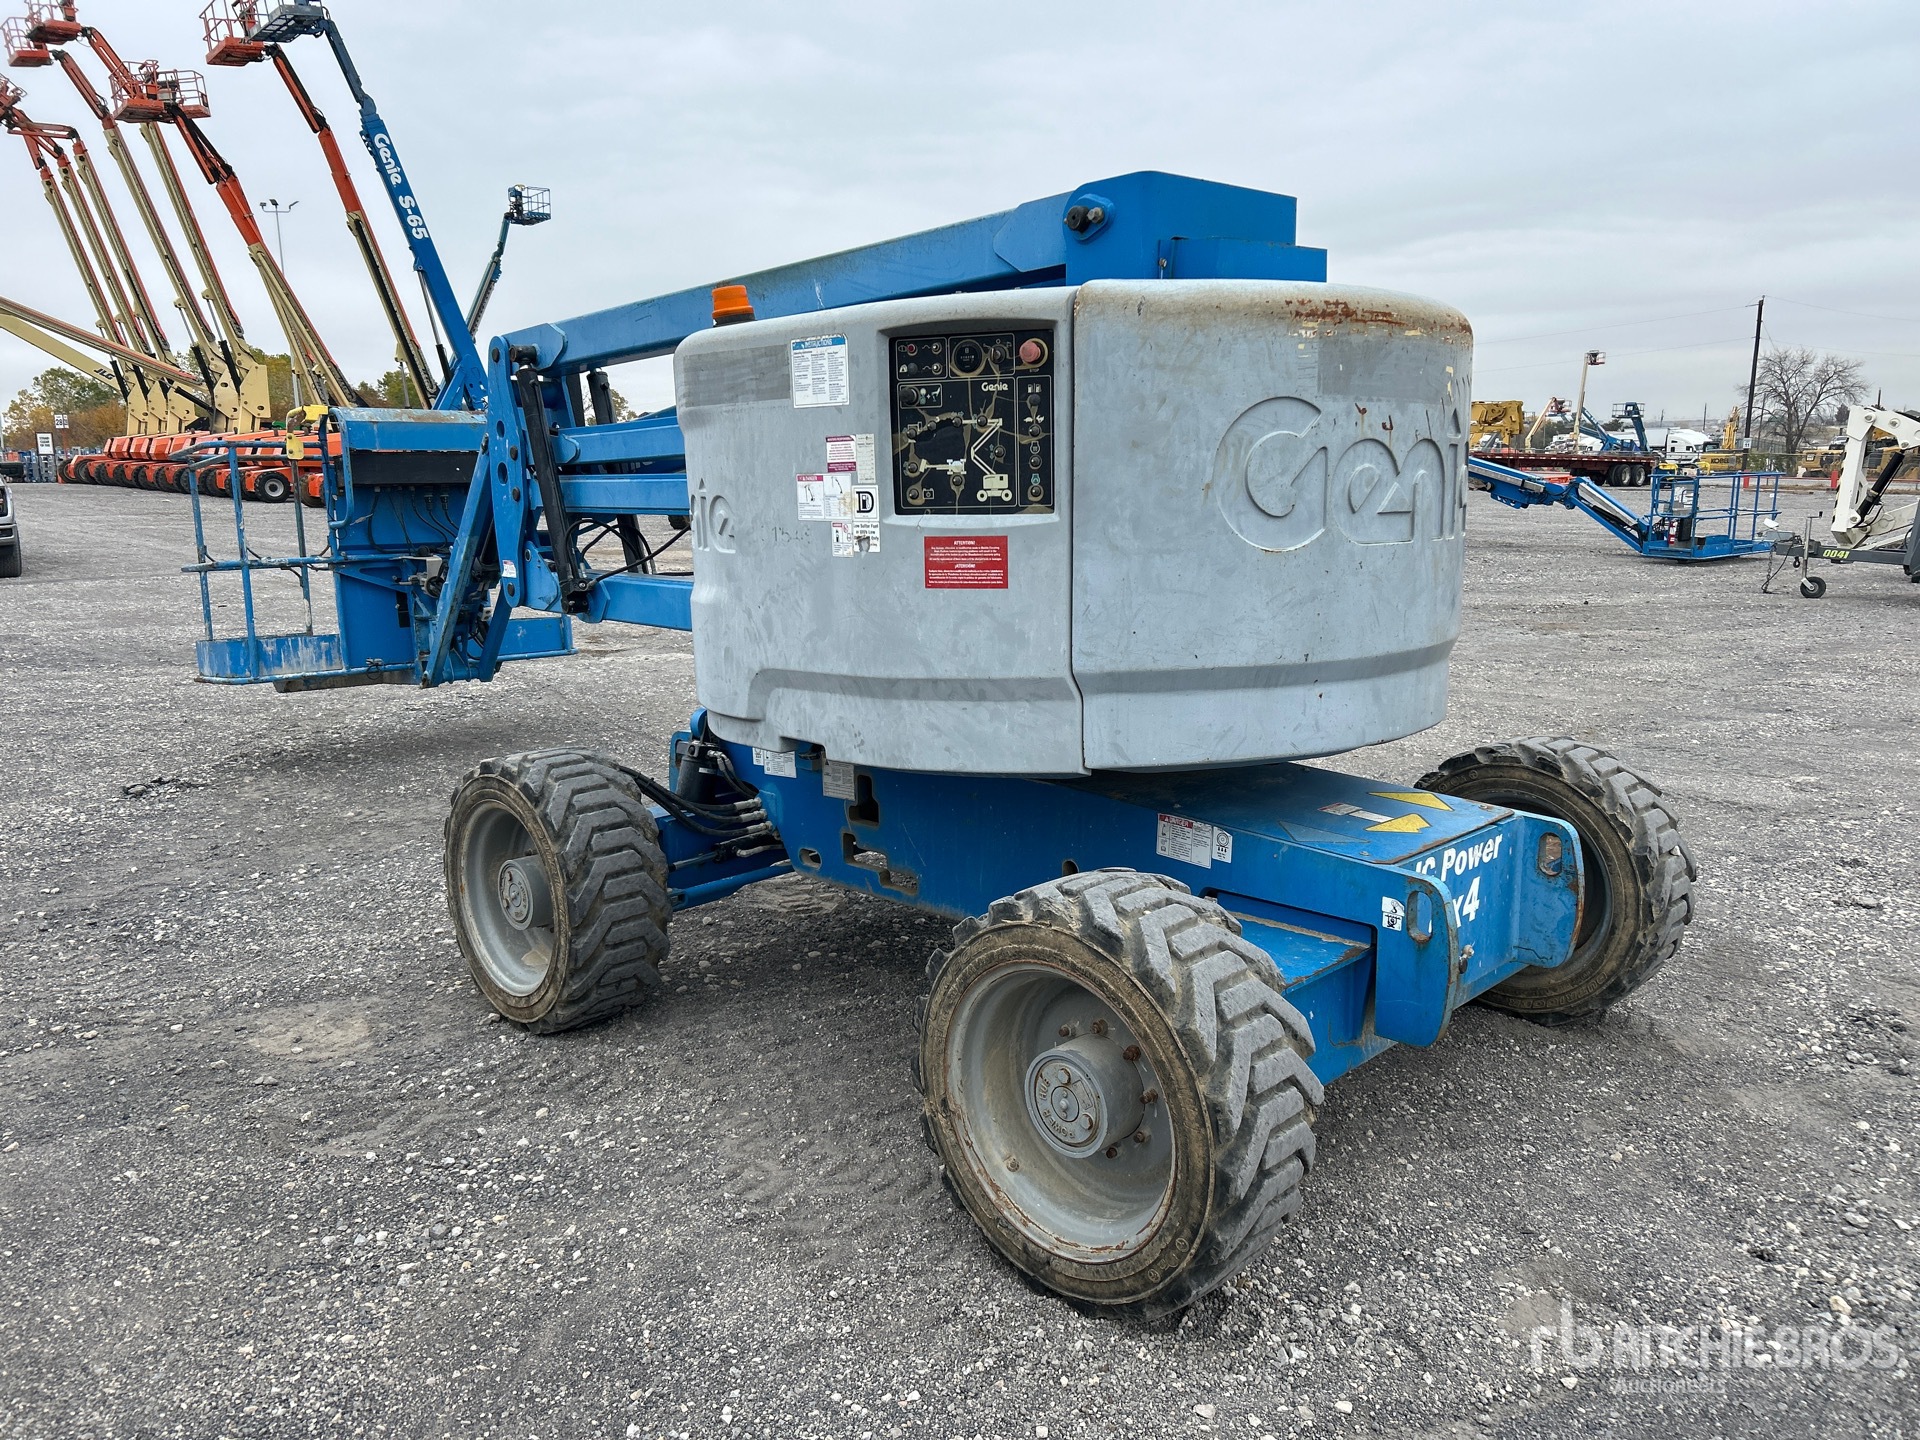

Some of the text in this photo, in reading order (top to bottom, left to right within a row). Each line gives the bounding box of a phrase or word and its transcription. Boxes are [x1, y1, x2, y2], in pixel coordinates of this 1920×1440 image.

[374, 133, 430, 239] Genie S-65
[93, 368, 115, 379] JLG
[981, 381, 1008, 391] Genie
[1822, 549, 1850, 559] 0041
[1440, 833, 1503, 882] Power
[1038, 1077, 1052, 1101] HUB
